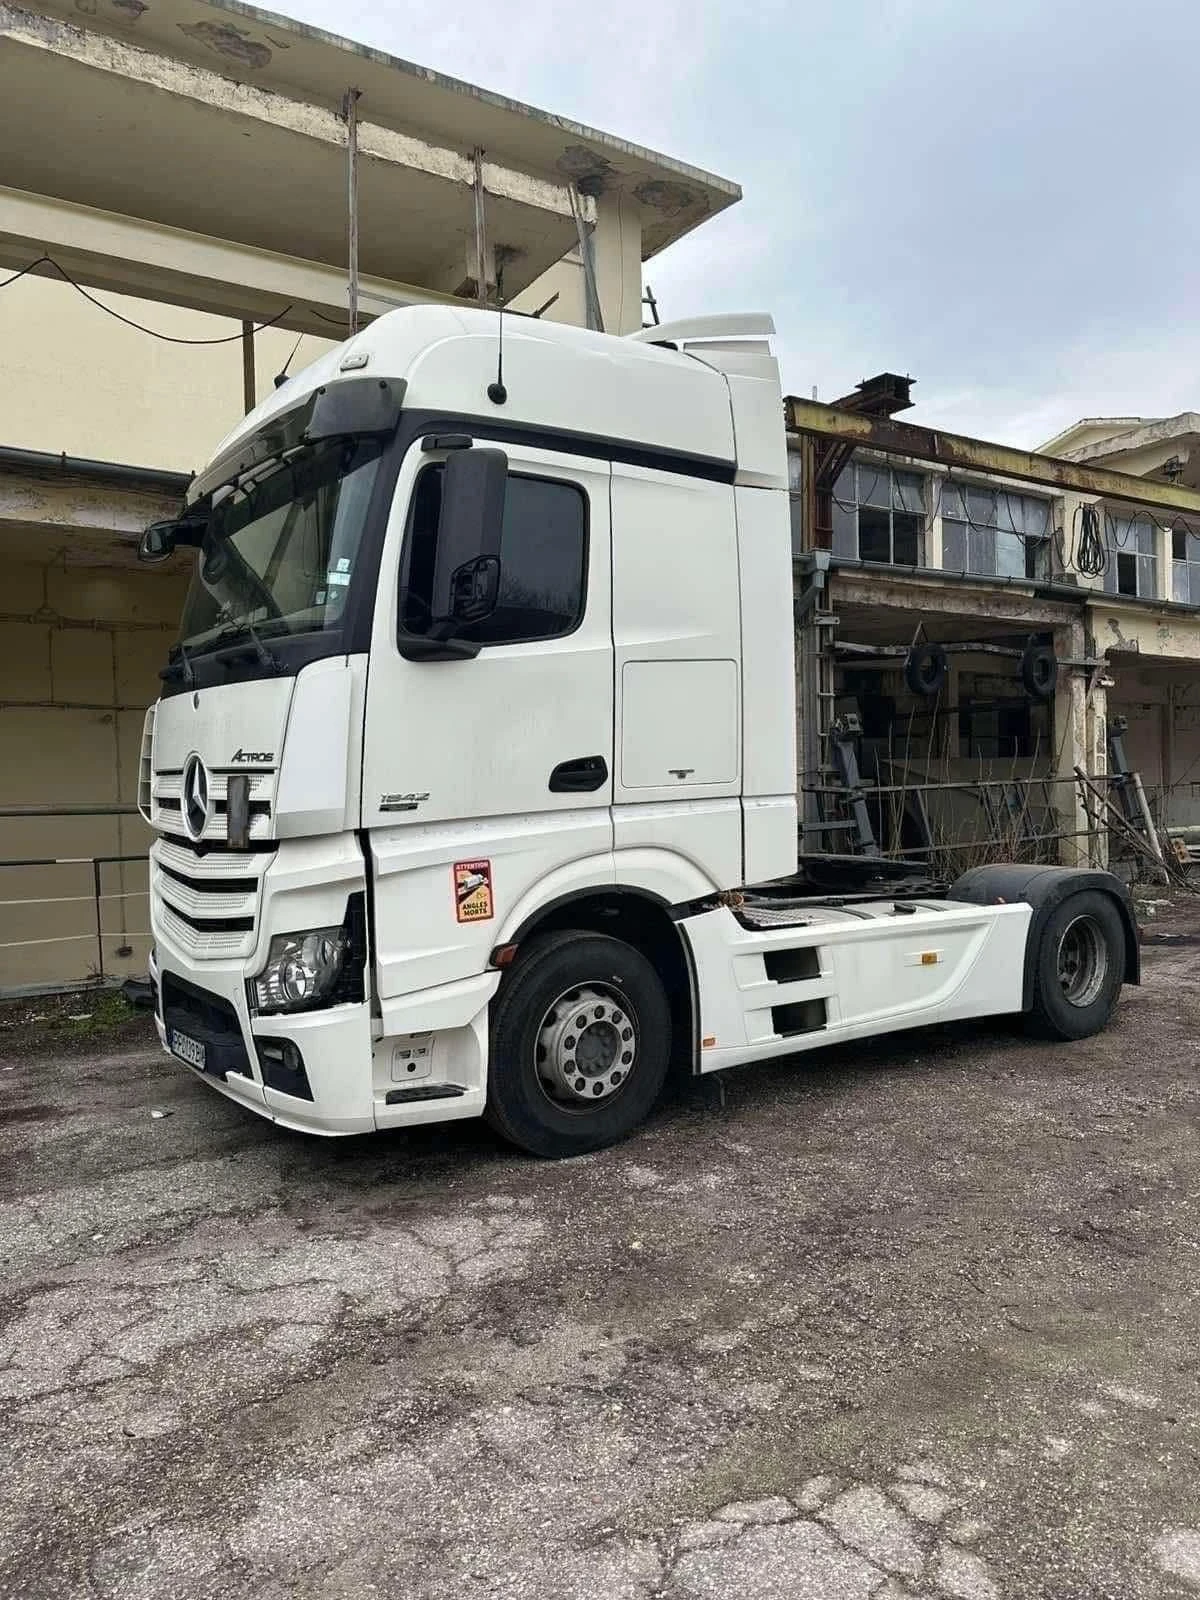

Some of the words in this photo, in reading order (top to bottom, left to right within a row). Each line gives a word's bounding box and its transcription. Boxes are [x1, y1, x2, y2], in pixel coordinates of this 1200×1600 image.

[231, 748, 274, 762] ACTROS
[455, 862, 489, 870] ATTENTION
[462, 901, 488, 910] ANGLES
[463, 908, 488, 917] MORTS
